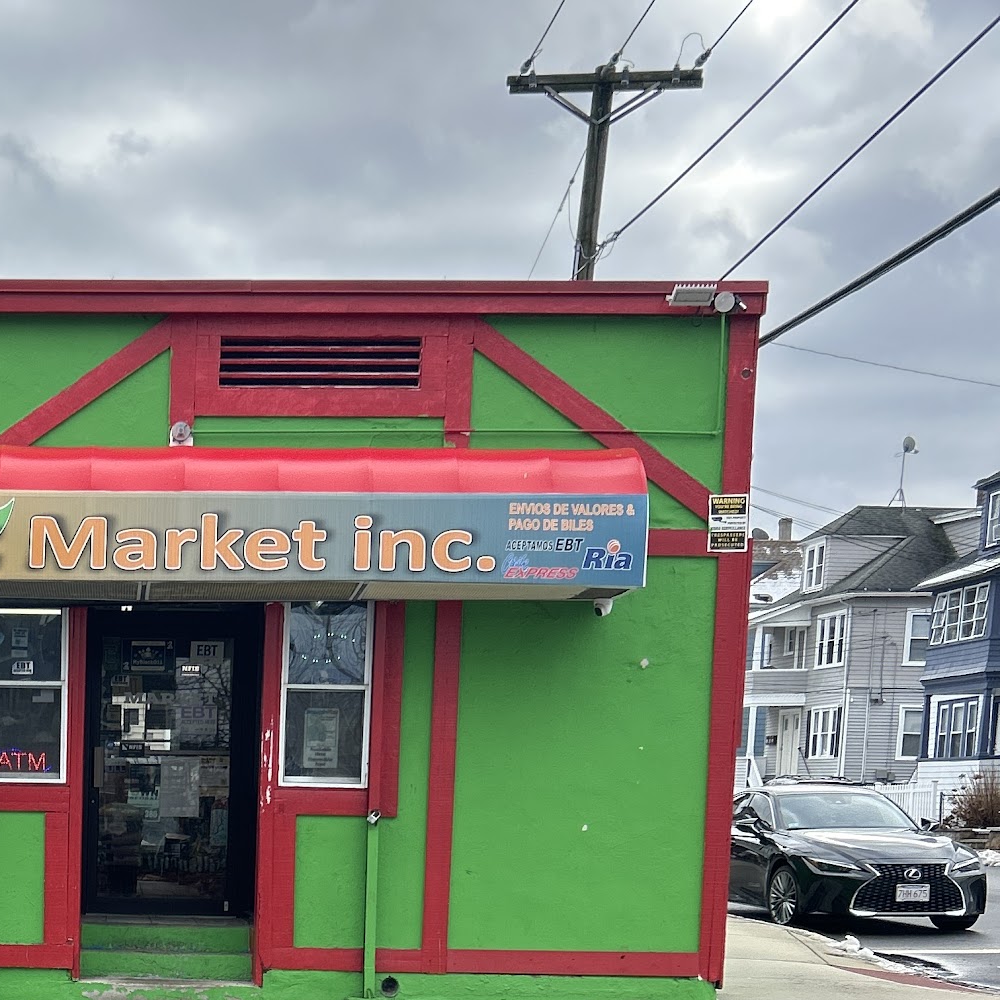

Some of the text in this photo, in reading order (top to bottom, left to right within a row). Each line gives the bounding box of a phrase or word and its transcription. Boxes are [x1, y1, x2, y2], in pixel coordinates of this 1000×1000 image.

[509, 502, 635, 516] ENVIOS DE VALORES &
[508, 518, 594, 532] PAGO DE BILES
[28, 512, 327, 573] Market
[353, 515, 497, 574] inc.
[505, 538, 584, 552] ACEPTAMOS EBT
[582, 540, 633, 570] Ria
[504, 567, 579, 579] EXPRESS
[196, 644, 218, 656] EBT
[181, 706, 216, 718] EBT
